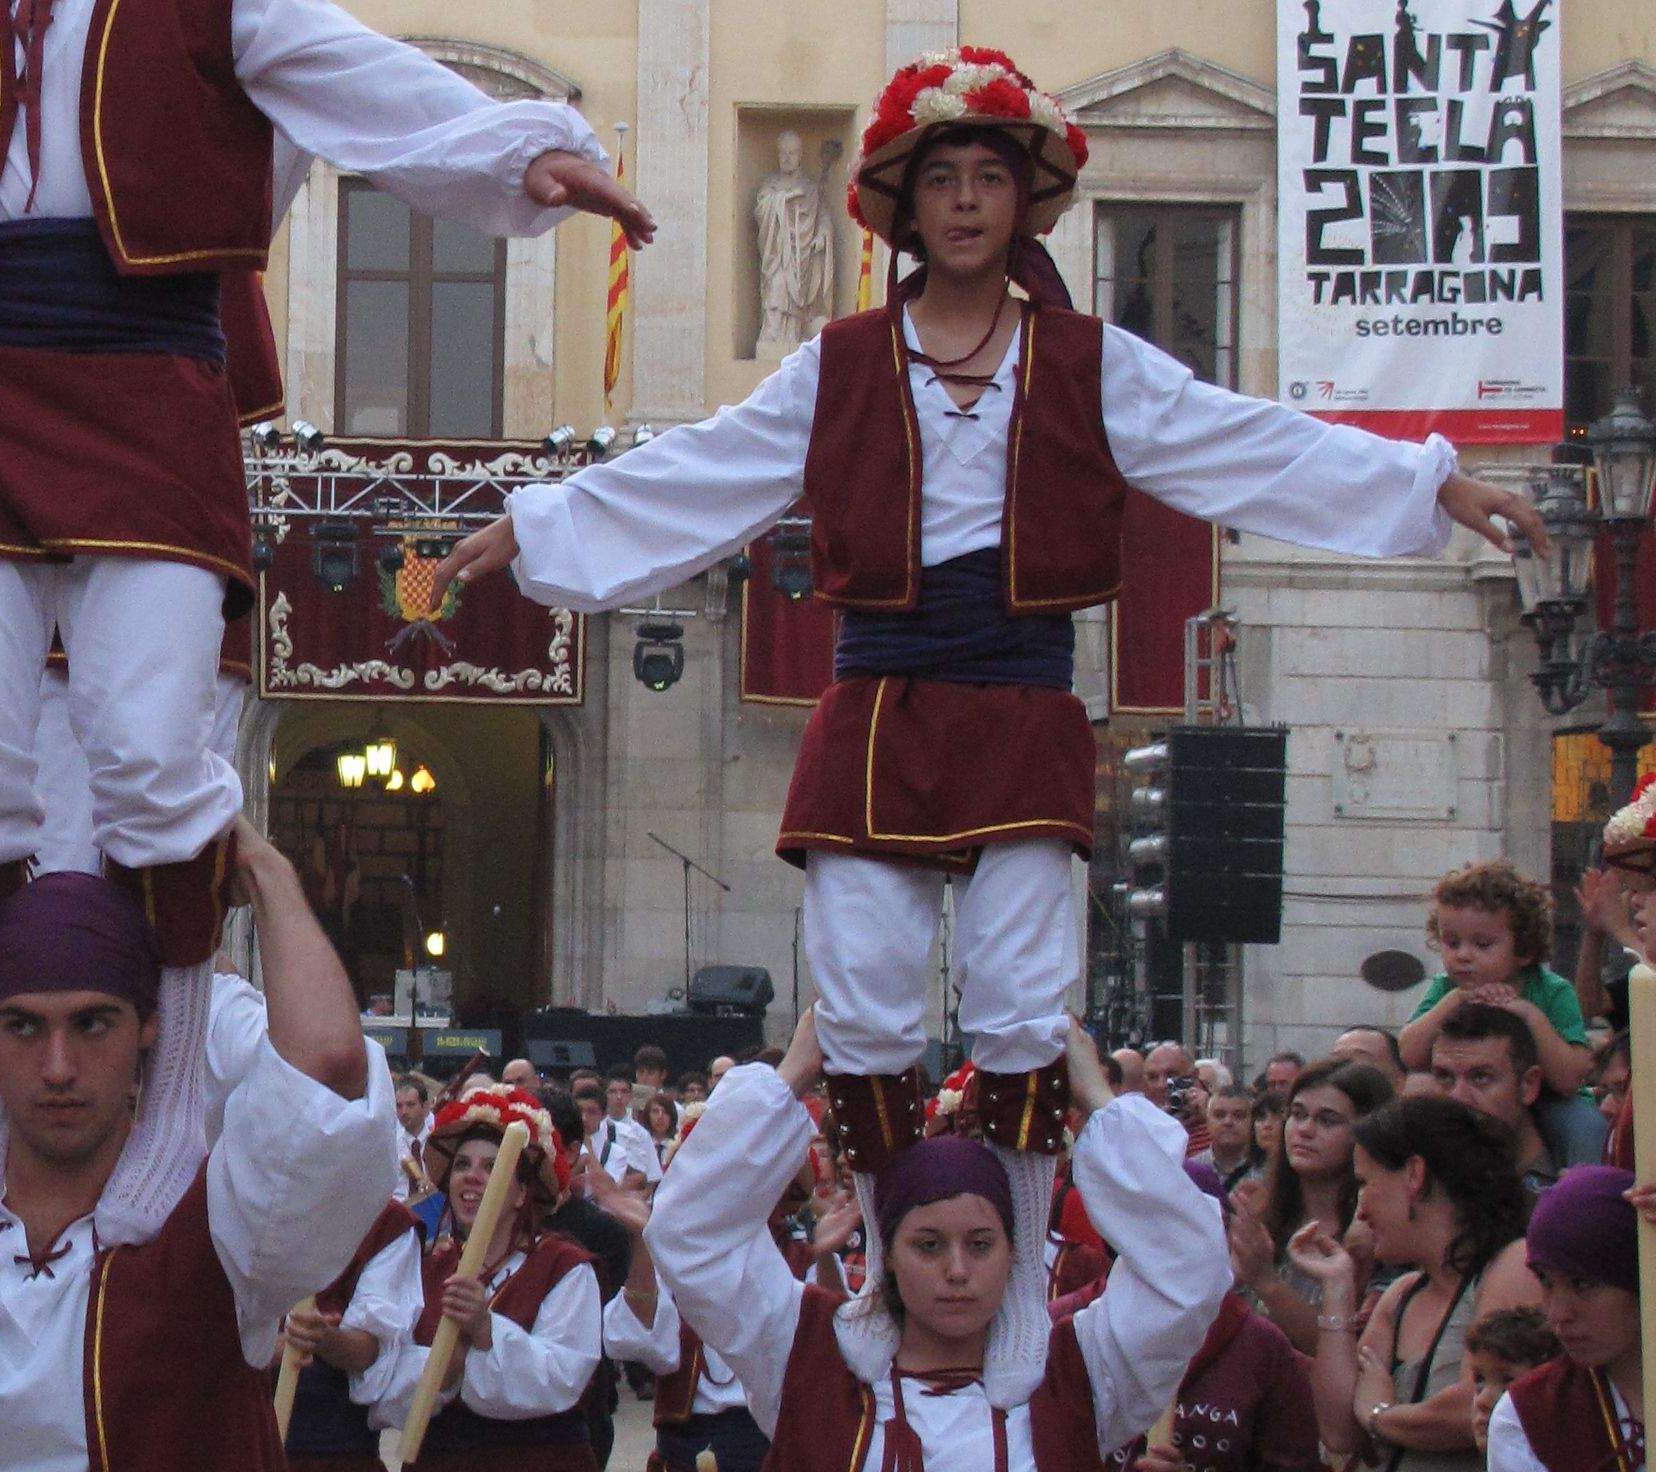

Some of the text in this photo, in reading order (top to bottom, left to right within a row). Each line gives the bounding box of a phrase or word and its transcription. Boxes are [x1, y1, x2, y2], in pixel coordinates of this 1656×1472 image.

[1297, 23, 1540, 95] SANTA
[1298, 95, 1539, 165] TECLA
[1306, 267, 1544, 306] TARRAGONA
[1355, 312, 1504, 337] setembre
